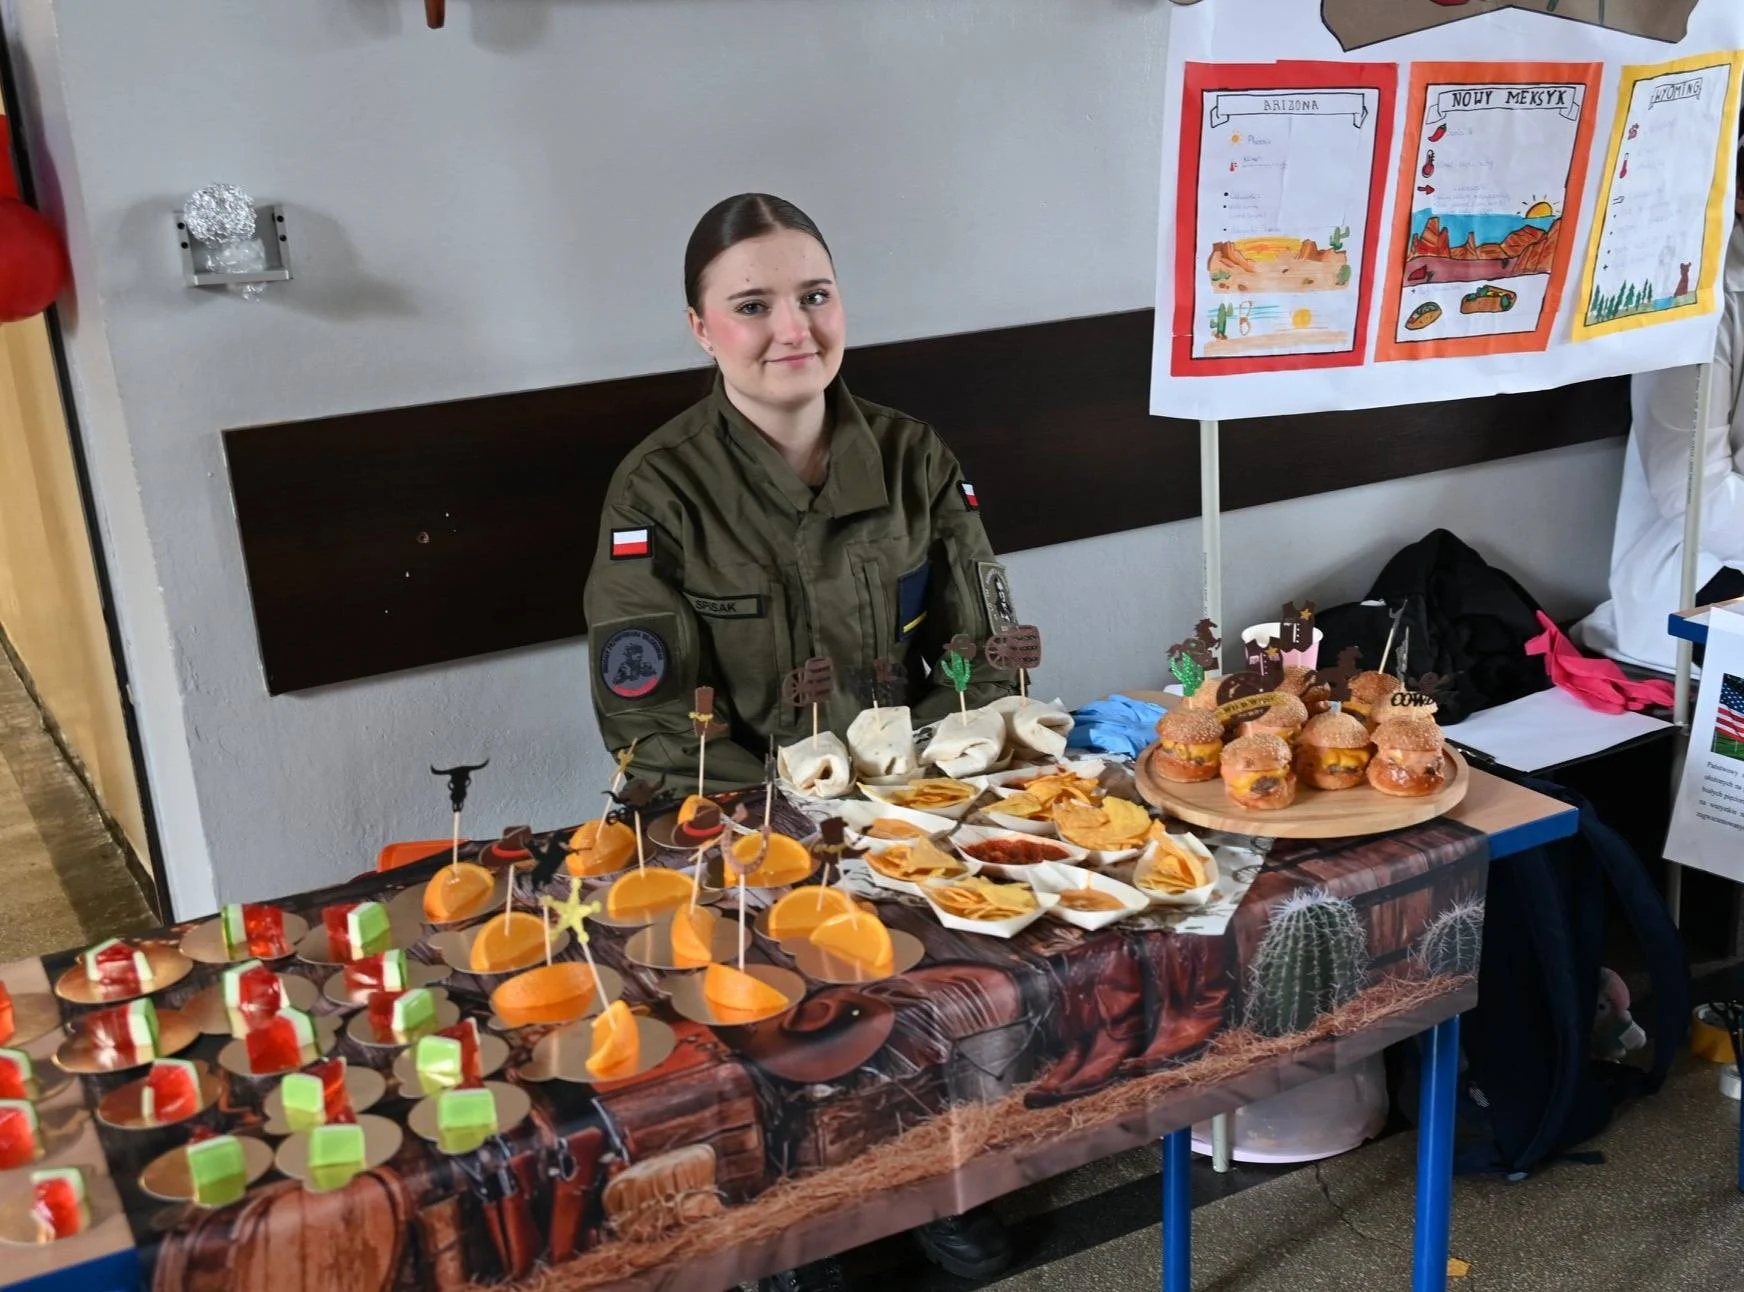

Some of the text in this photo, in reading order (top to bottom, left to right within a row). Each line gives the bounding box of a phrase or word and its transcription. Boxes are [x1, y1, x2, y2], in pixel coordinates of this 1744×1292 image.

[1451, 88, 1568, 108] NOWY MEKSYK
[1653, 79, 1701, 102] WYOMING
[1263, 99, 1319, 112] ARIZONA
